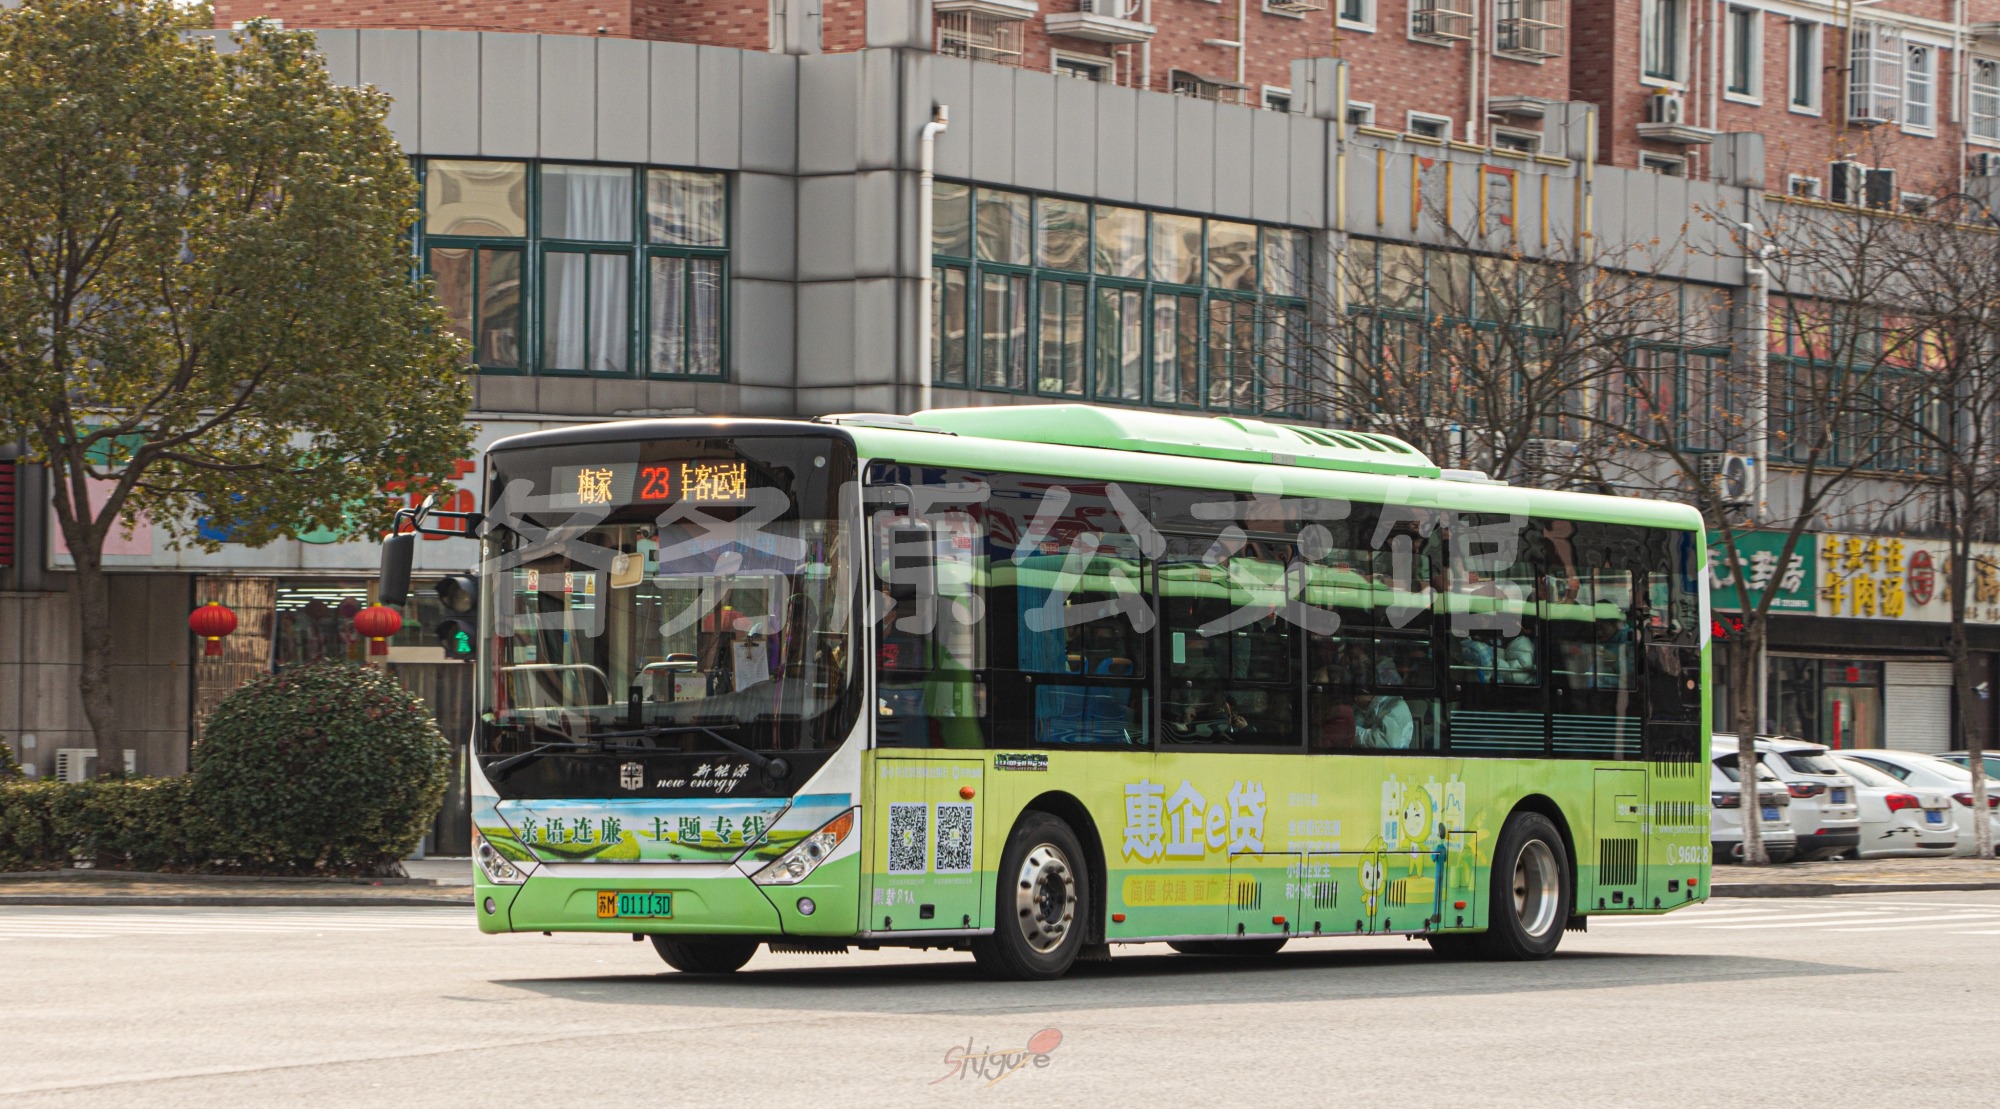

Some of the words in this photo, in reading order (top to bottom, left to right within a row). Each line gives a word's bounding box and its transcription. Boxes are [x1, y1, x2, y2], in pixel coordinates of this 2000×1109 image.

[578, 468, 613, 504] 梅家
[641, 467, 670, 500] 23
[1822, 572, 1905, 617] 牛肉汤
[656, 778, 687, 788] new
[690, 777, 740, 794] energy
[692, 763, 750, 779] 新能源
[647, 815, 769, 845] 主题专线
[1122, 778, 1267, 862] 惠企e贷
[1678, 845, 1709, 864] 96028
[1162, 879, 1187, 902] 快捷
